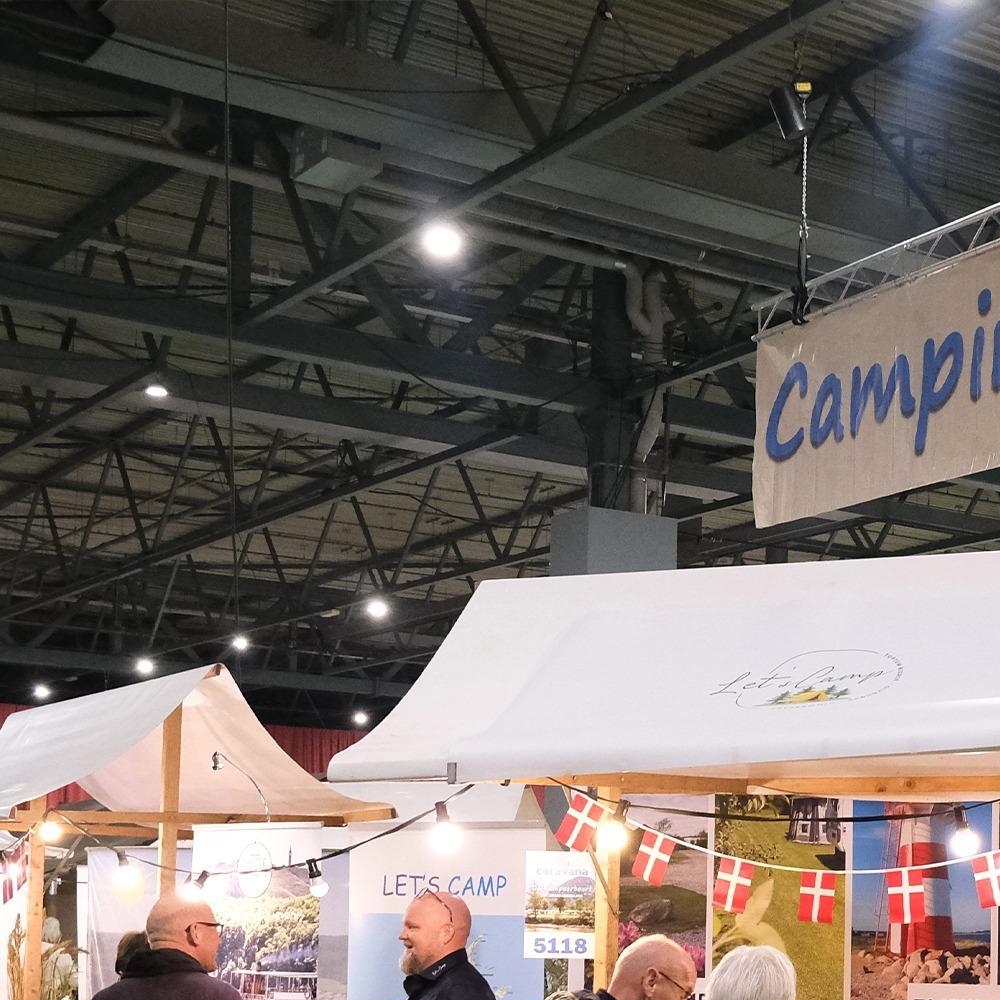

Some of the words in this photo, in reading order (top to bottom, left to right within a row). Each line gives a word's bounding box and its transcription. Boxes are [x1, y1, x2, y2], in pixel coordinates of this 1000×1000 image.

[383, 874, 440, 897] LET'S
[448, 875, 507, 897] CAMP
[533, 937, 588, 954] 5118
